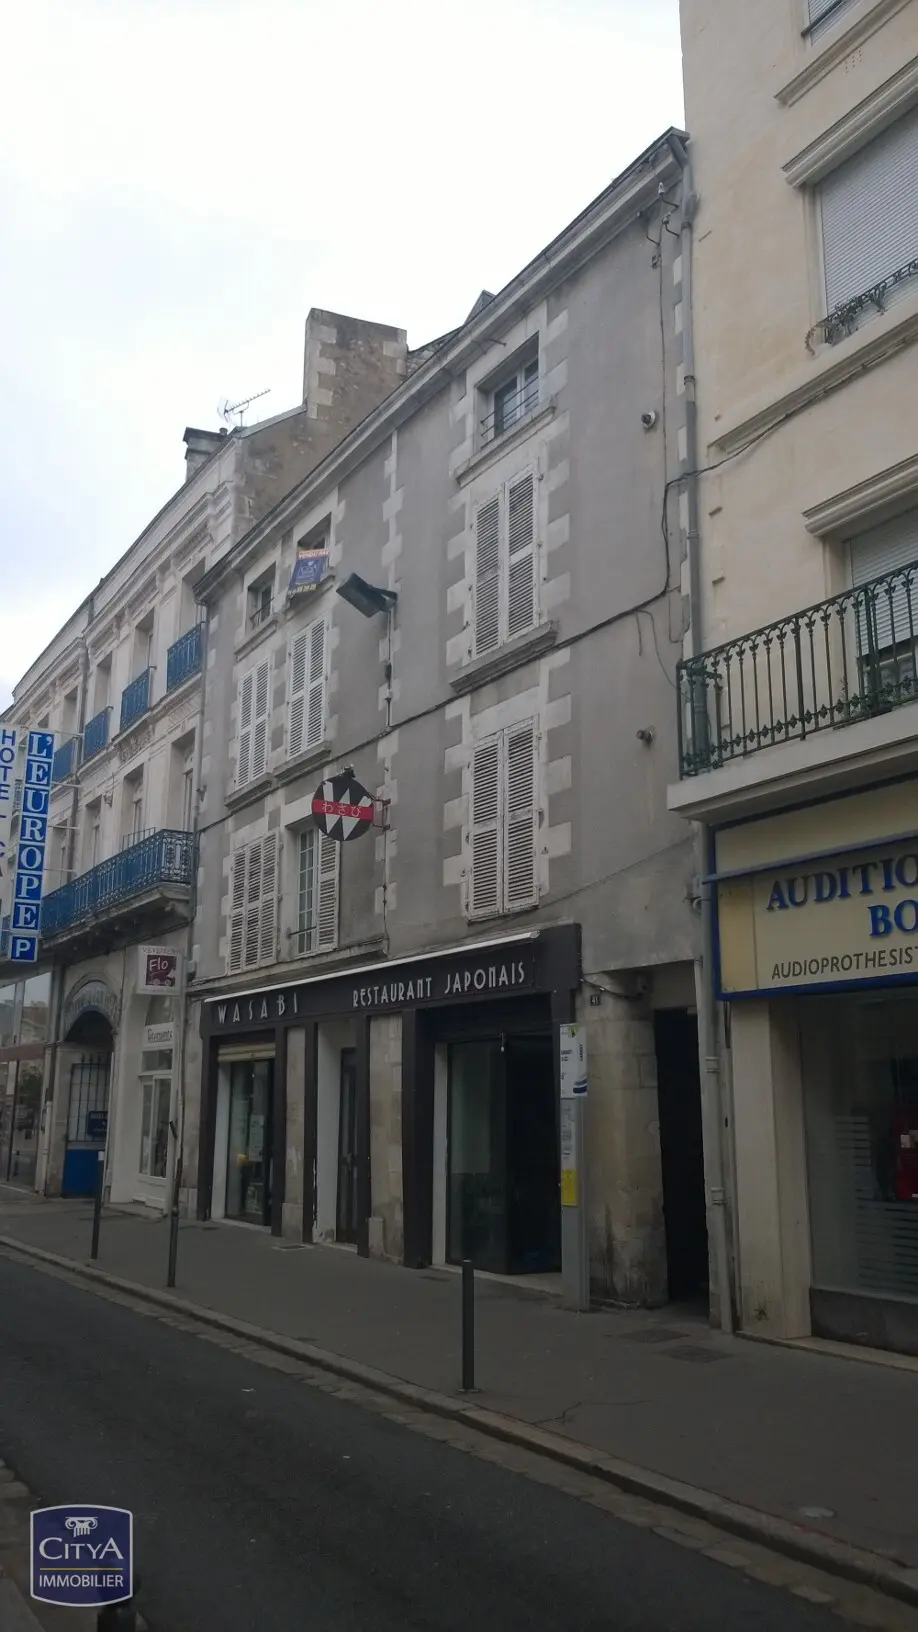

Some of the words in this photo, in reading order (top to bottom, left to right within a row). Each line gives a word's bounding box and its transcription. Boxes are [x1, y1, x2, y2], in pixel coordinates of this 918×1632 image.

[322, 801, 361, 817] わさび
[16, 733, 53, 928] L'EUROPE
[766, 854, 918, 911] AUDITIO
[772, 946, 918, 980] AUDIOPROTHESIS
[353, 977, 432, 1008] RESTAURANT
[444, 961, 525, 994] JAPONAIS
[218, 992, 298, 1024] WASABI
